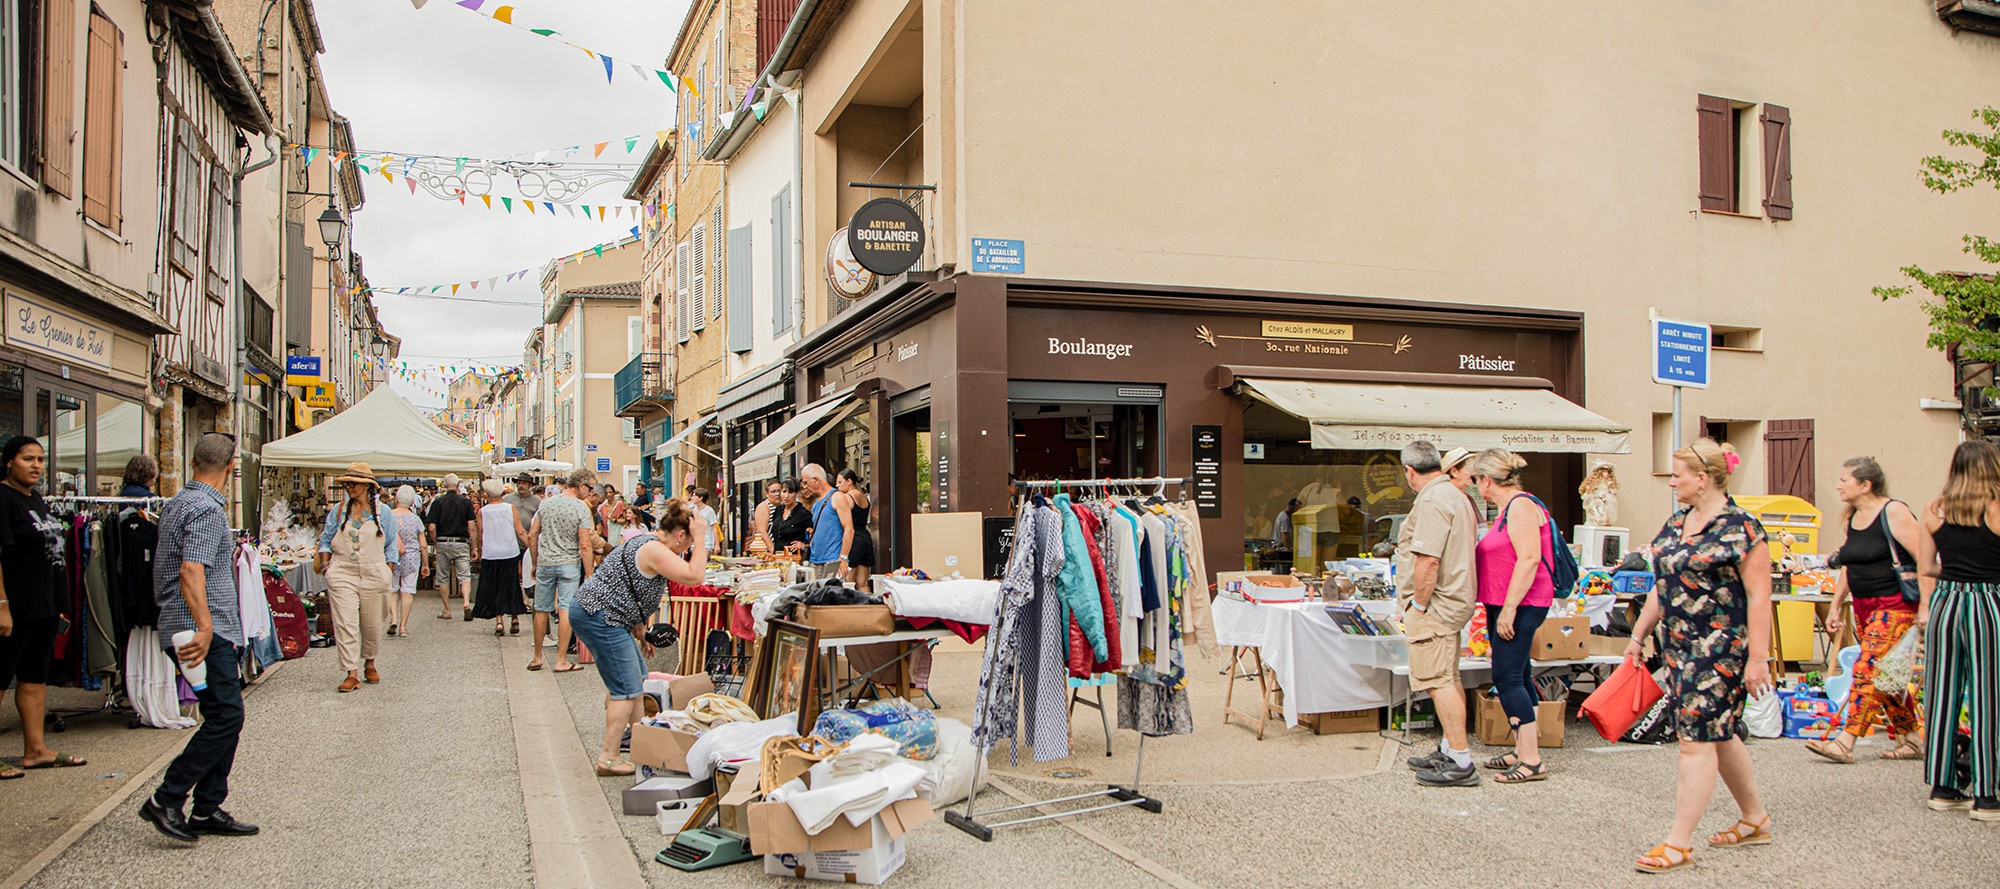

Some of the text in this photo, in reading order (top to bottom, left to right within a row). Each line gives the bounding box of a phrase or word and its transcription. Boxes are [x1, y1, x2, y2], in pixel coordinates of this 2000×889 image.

[869, 220, 906, 230] ARTISAN
[857, 229, 919, 242] BOULANGER
[865, 242, 911, 252] & BANETTE
[19, 307, 36, 334] Le
[40, 315, 73, 347] Grenier
[76, 328, 85, 350] de
[1268, 325, 1283, 333] Chez
[1312, 328, 1346, 336] MALLAURY
[1662, 328, 1703, 341] ARRÊT MINUTE
[1047, 337, 1133, 360] Boulanger
[1284, 344, 1300, 352] rue
[1304, 344, 1349, 354] Nationale
[1660, 340, 1704, 352] STATIONNEMENT
[291, 362, 309, 370] afer
[1459, 354, 1515, 371] Pâtissier
[1675, 367, 1683, 375] 15
[1377, 431, 1387, 442] 05
[1389, 432, 1401, 441] 62
[1430, 434, 1442, 444] 24
[1550, 434, 1560, 444] de
[1565, 434, 1596, 444] Banette
